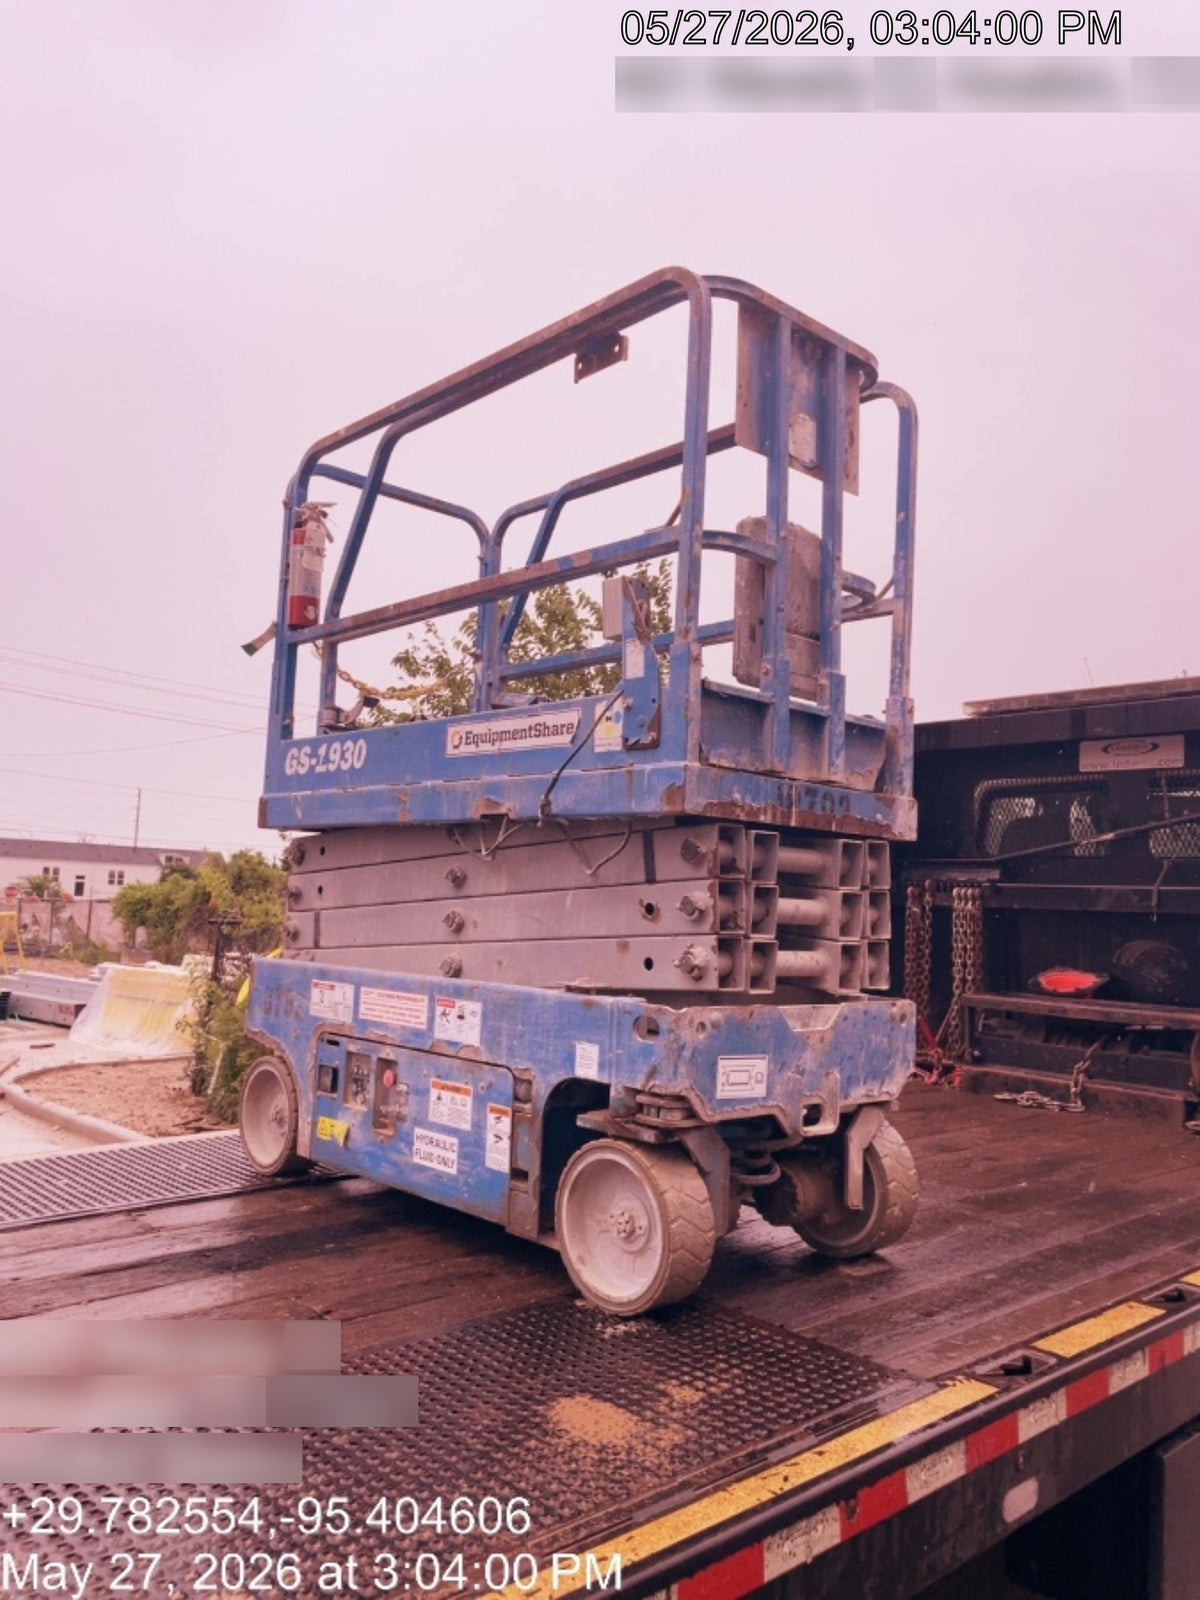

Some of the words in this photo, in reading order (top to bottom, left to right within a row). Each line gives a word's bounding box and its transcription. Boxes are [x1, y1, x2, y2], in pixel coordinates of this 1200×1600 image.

[463, 720, 576, 747] EquipmentShare
[284, 738, 367, 776] GS-1930
[416, 1133, 456, 1152] HYDRAULIC
[436, 1153, 456, 1169] ONLY
